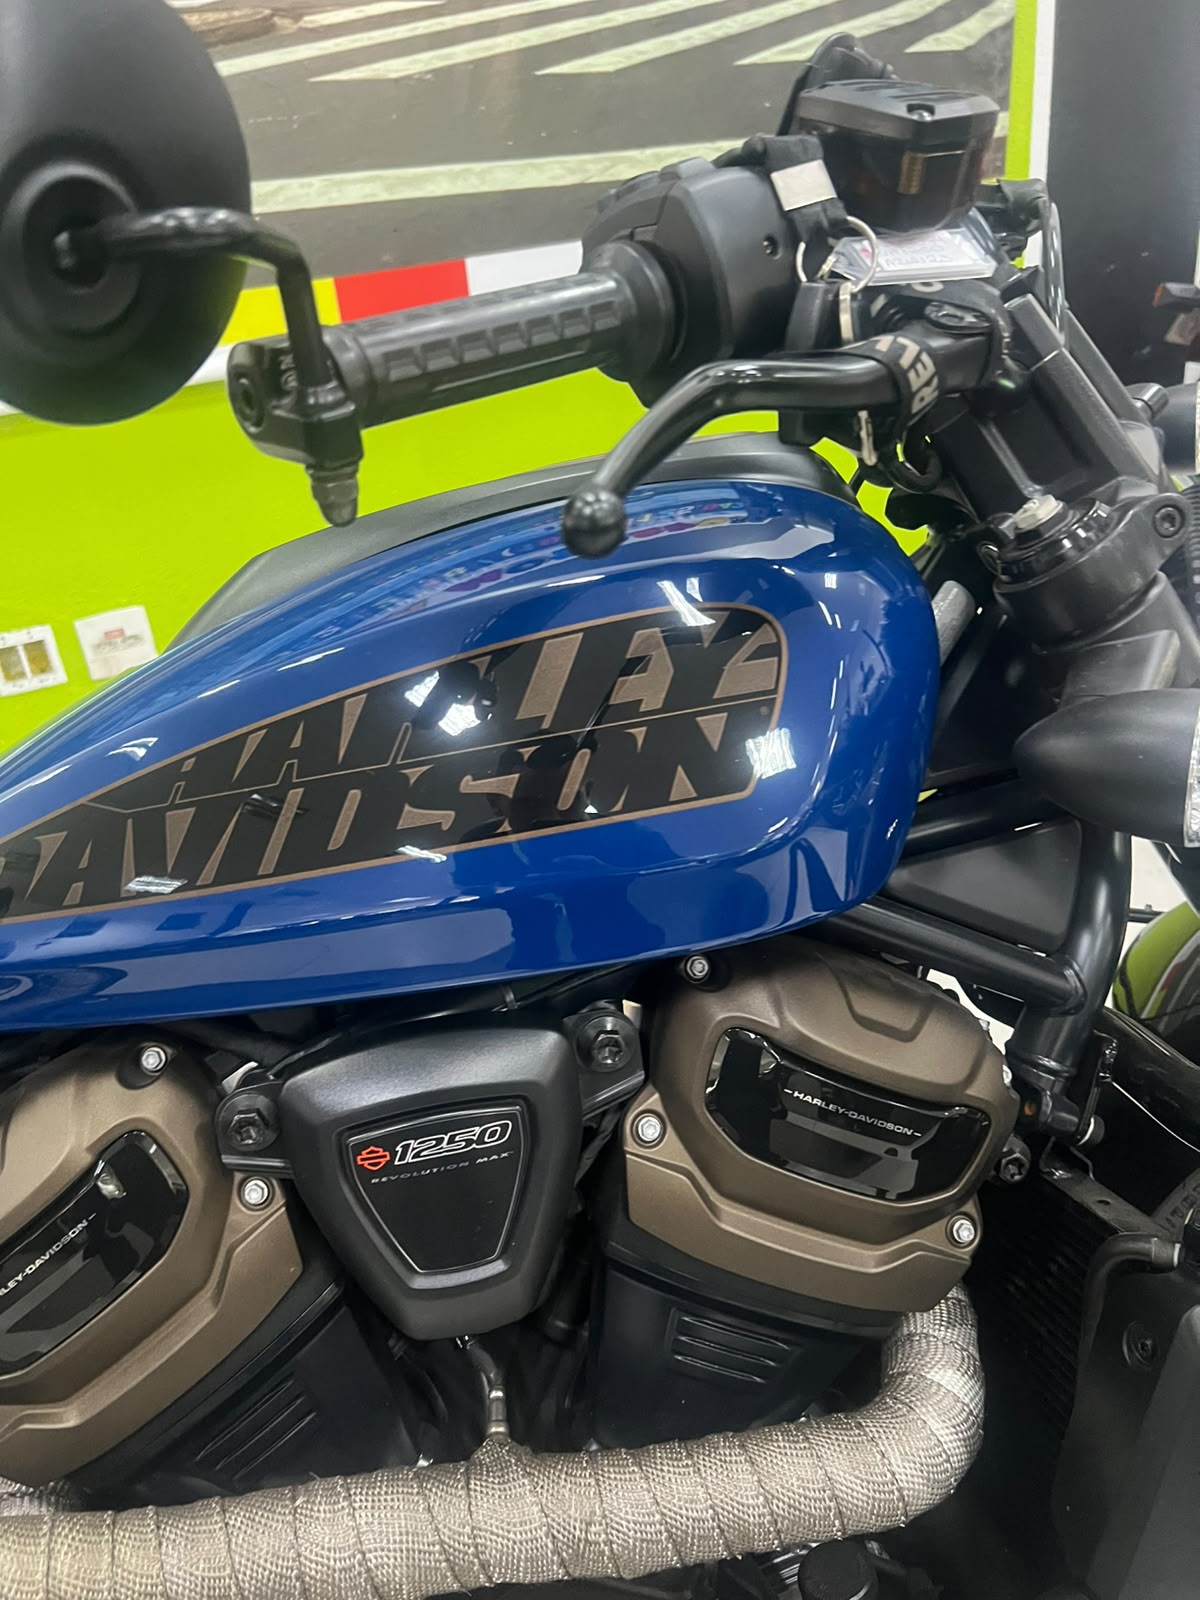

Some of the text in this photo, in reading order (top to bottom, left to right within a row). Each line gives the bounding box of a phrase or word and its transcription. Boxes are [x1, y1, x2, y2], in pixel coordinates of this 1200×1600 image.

[85, 604, 780, 813] HARLEY
[394, 1119, 513, 1166] 1250
[371, 1151, 511, 1184] REVOLUTION MAX
